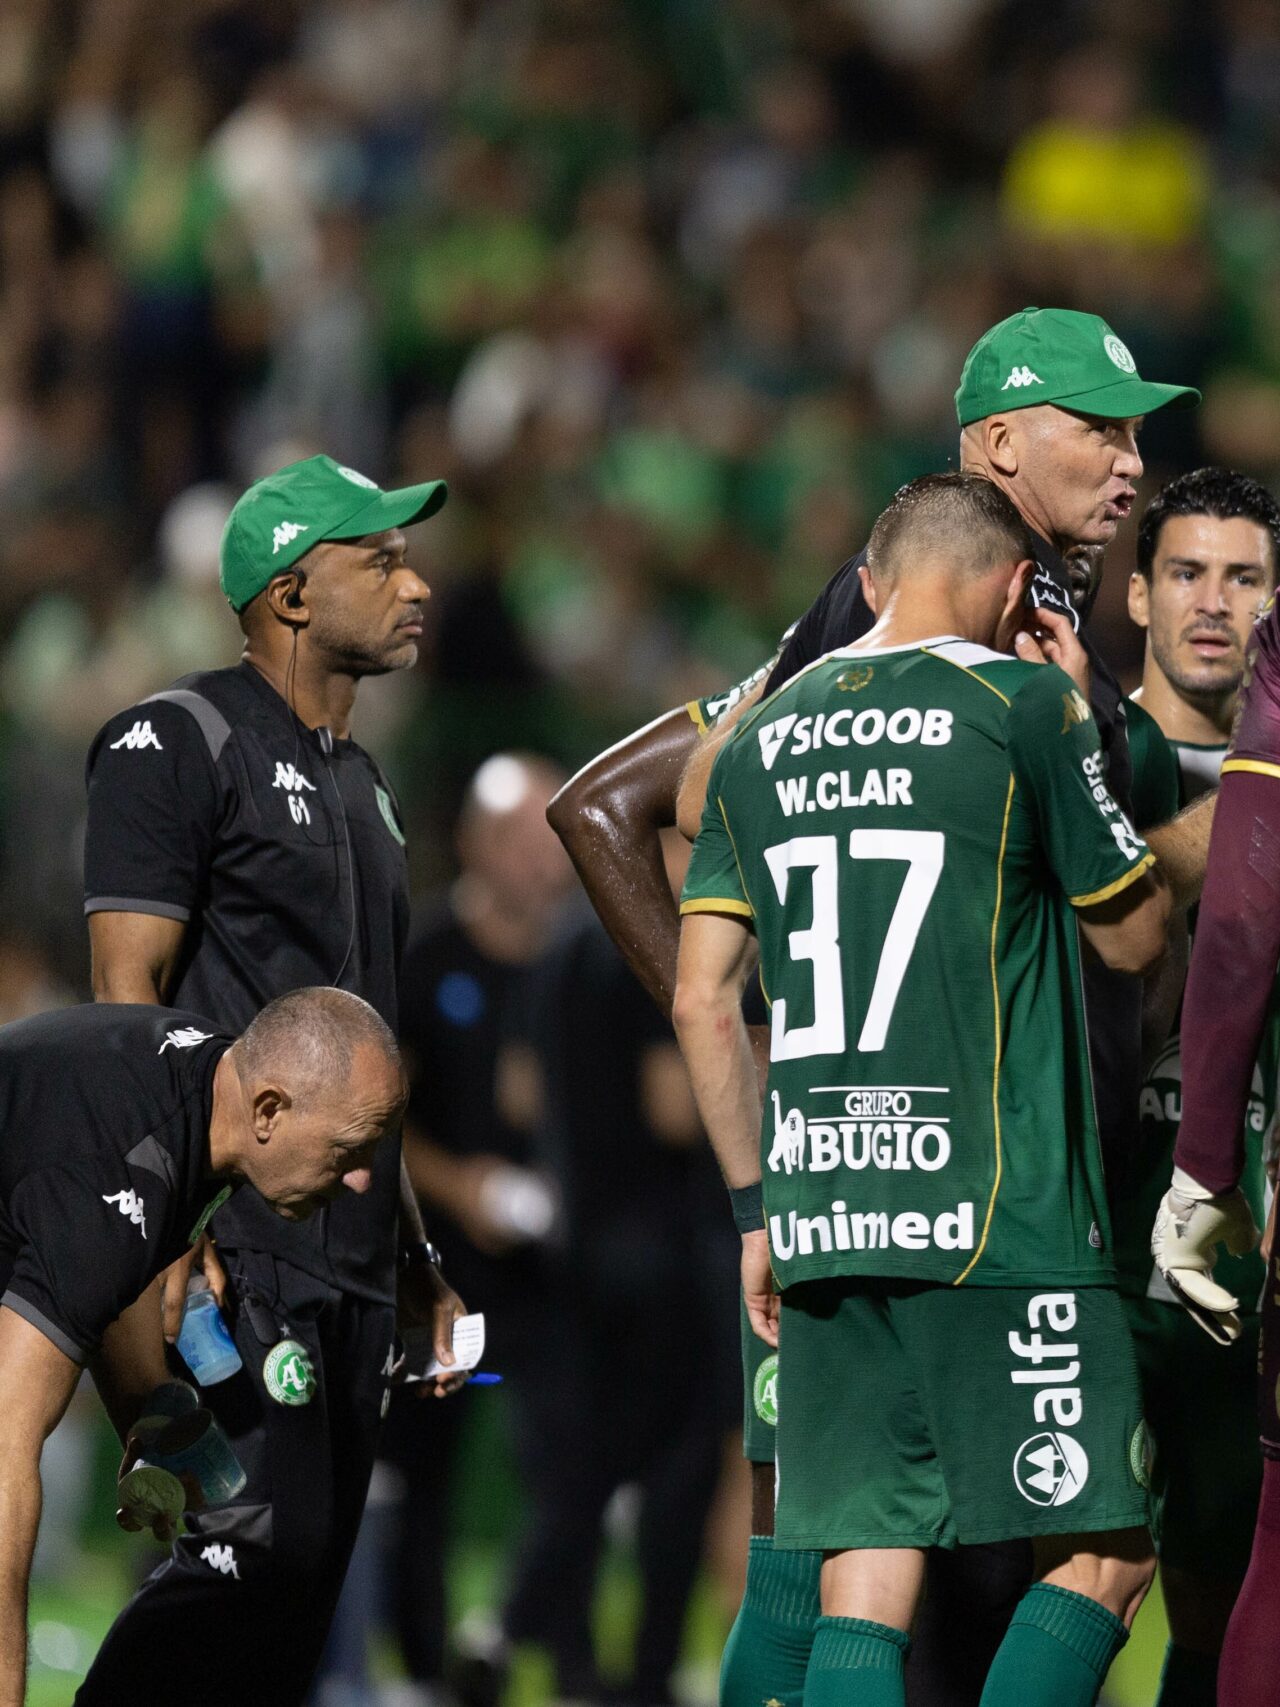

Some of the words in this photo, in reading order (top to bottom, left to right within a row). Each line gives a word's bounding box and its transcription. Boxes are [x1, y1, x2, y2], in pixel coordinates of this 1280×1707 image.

[790, 707, 954, 756] SICOOB
[776, 768, 913, 816] W.CLAR
[763, 828, 946, 1063] 37
[844, 1091, 912, 1117] GRUPO
[808, 1124, 951, 1172] BUGIO
[770, 1200, 974, 1261] Unimed
[1008, 1293, 1082, 1426] alfa
